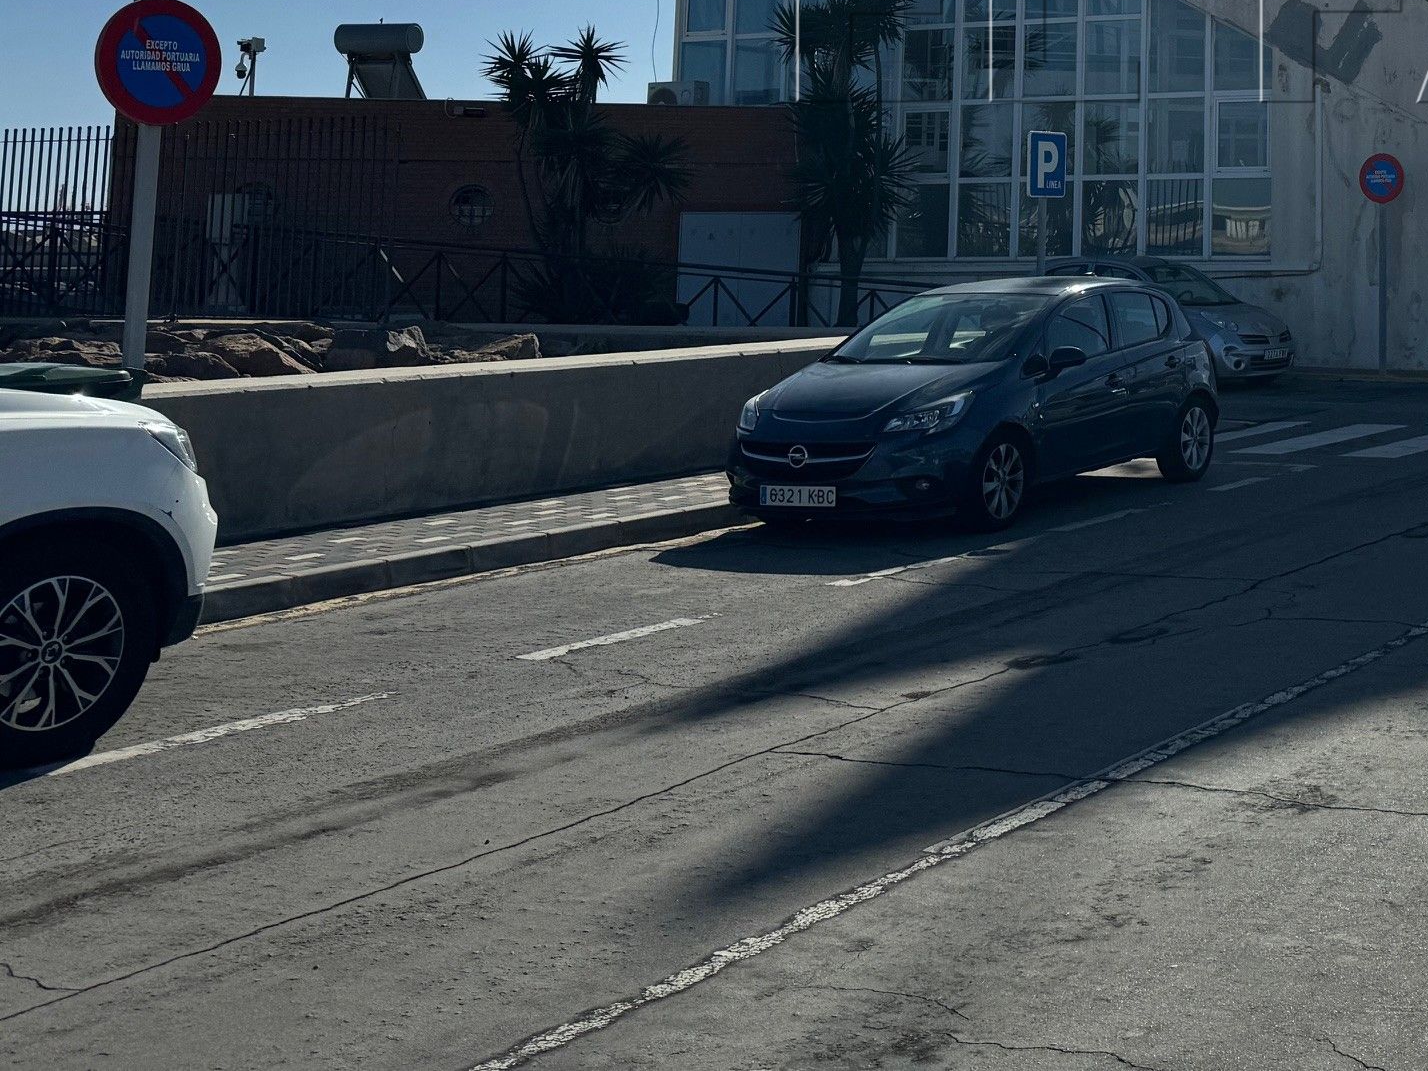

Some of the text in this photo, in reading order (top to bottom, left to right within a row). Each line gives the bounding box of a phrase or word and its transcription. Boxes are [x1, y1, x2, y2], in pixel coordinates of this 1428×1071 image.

[146, 39, 178, 51] EXCEPTO
[120, 50, 200, 62] AUTORIDAD PORTUARIA
[132, 60, 191, 72] LLAMAMOS GRUA
[1037, 140, 1059, 188] P
[769, 487, 834, 505] 6321 KBC
